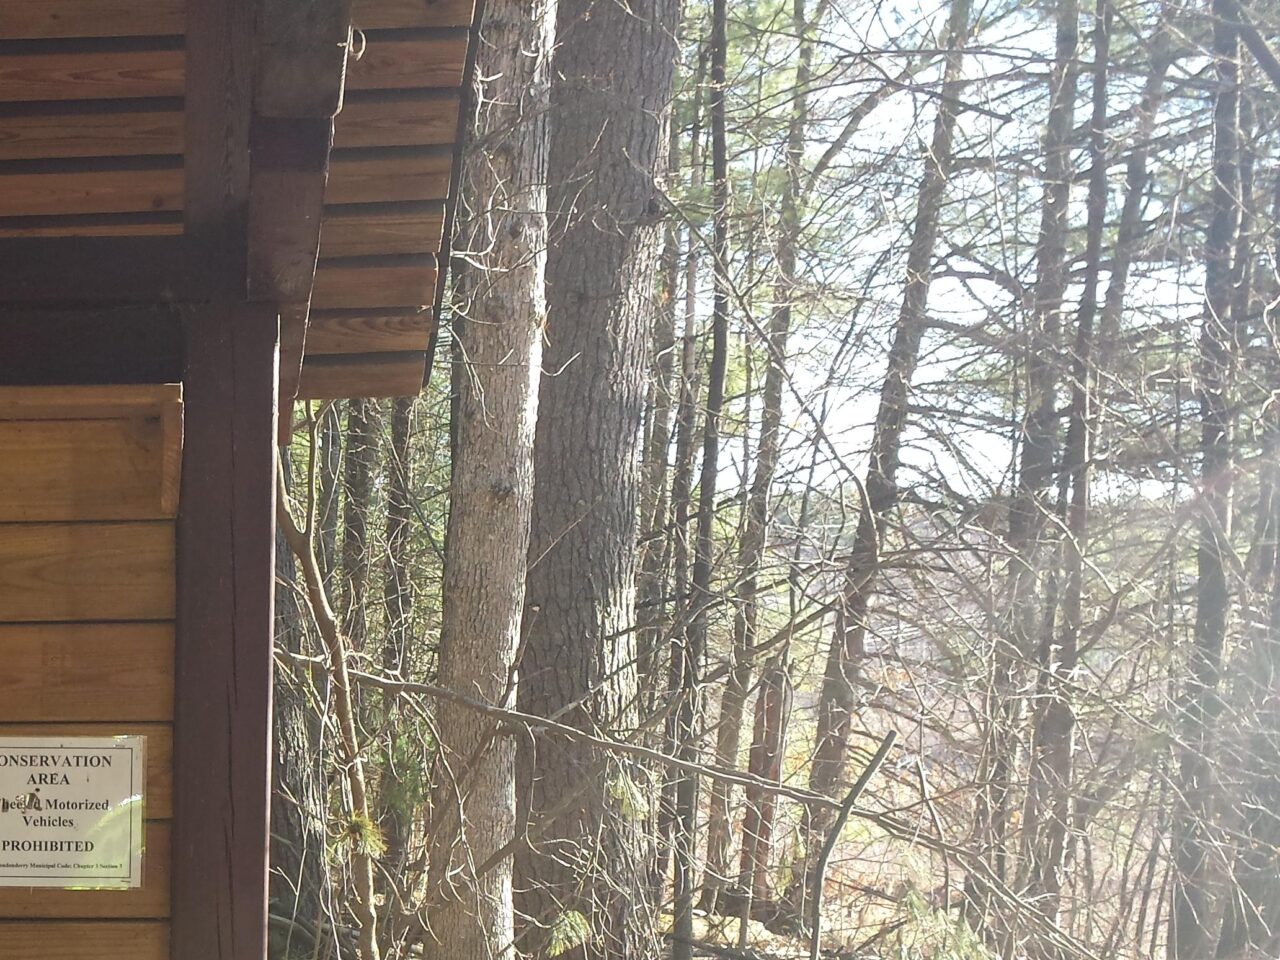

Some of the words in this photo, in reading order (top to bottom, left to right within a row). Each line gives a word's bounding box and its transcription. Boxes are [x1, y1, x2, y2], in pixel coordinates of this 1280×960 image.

[27, 773, 70, 785] AREA
[45, 799, 109, 811] Motorized
[23, 816, 74, 828] Vehicles
[2, 840, 95, 853] PROHIBITED
